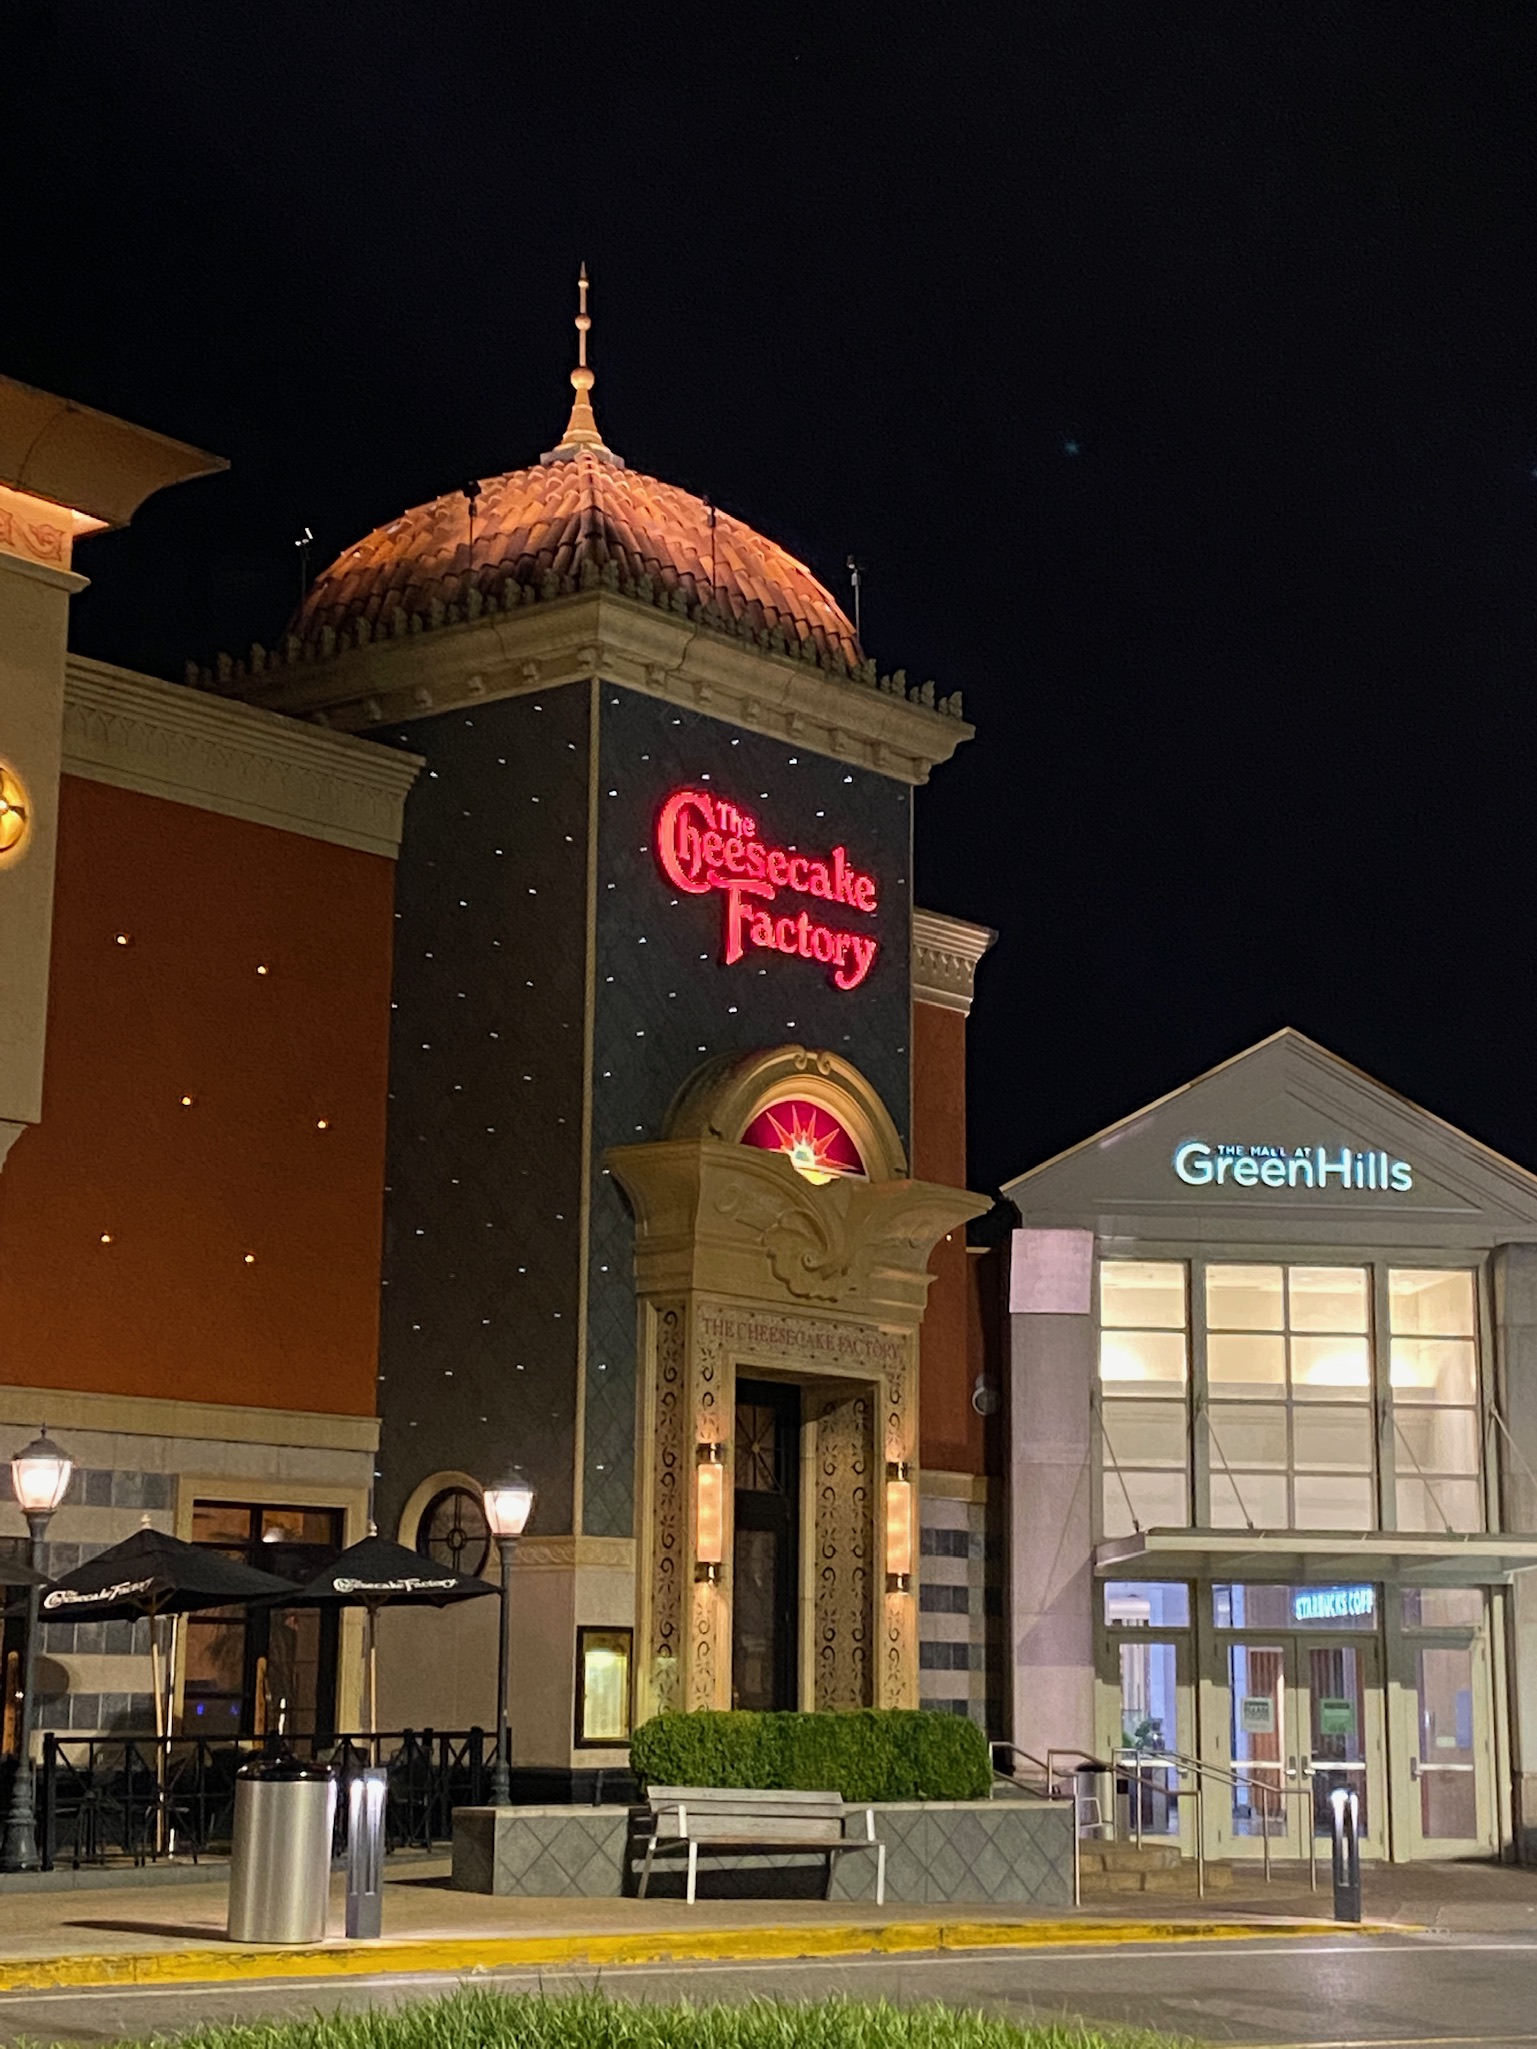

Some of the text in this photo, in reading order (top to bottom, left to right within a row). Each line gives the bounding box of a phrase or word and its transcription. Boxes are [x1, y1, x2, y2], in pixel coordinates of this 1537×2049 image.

[717, 800, 756, 838] The
[658, 791, 877, 912] Cheesecake
[706, 870, 877, 989] Factory
[1217, 1144, 1312, 1158] THE MALL AT
[702, 1317, 900, 1360] THE CHEESECAKE FACTORY
